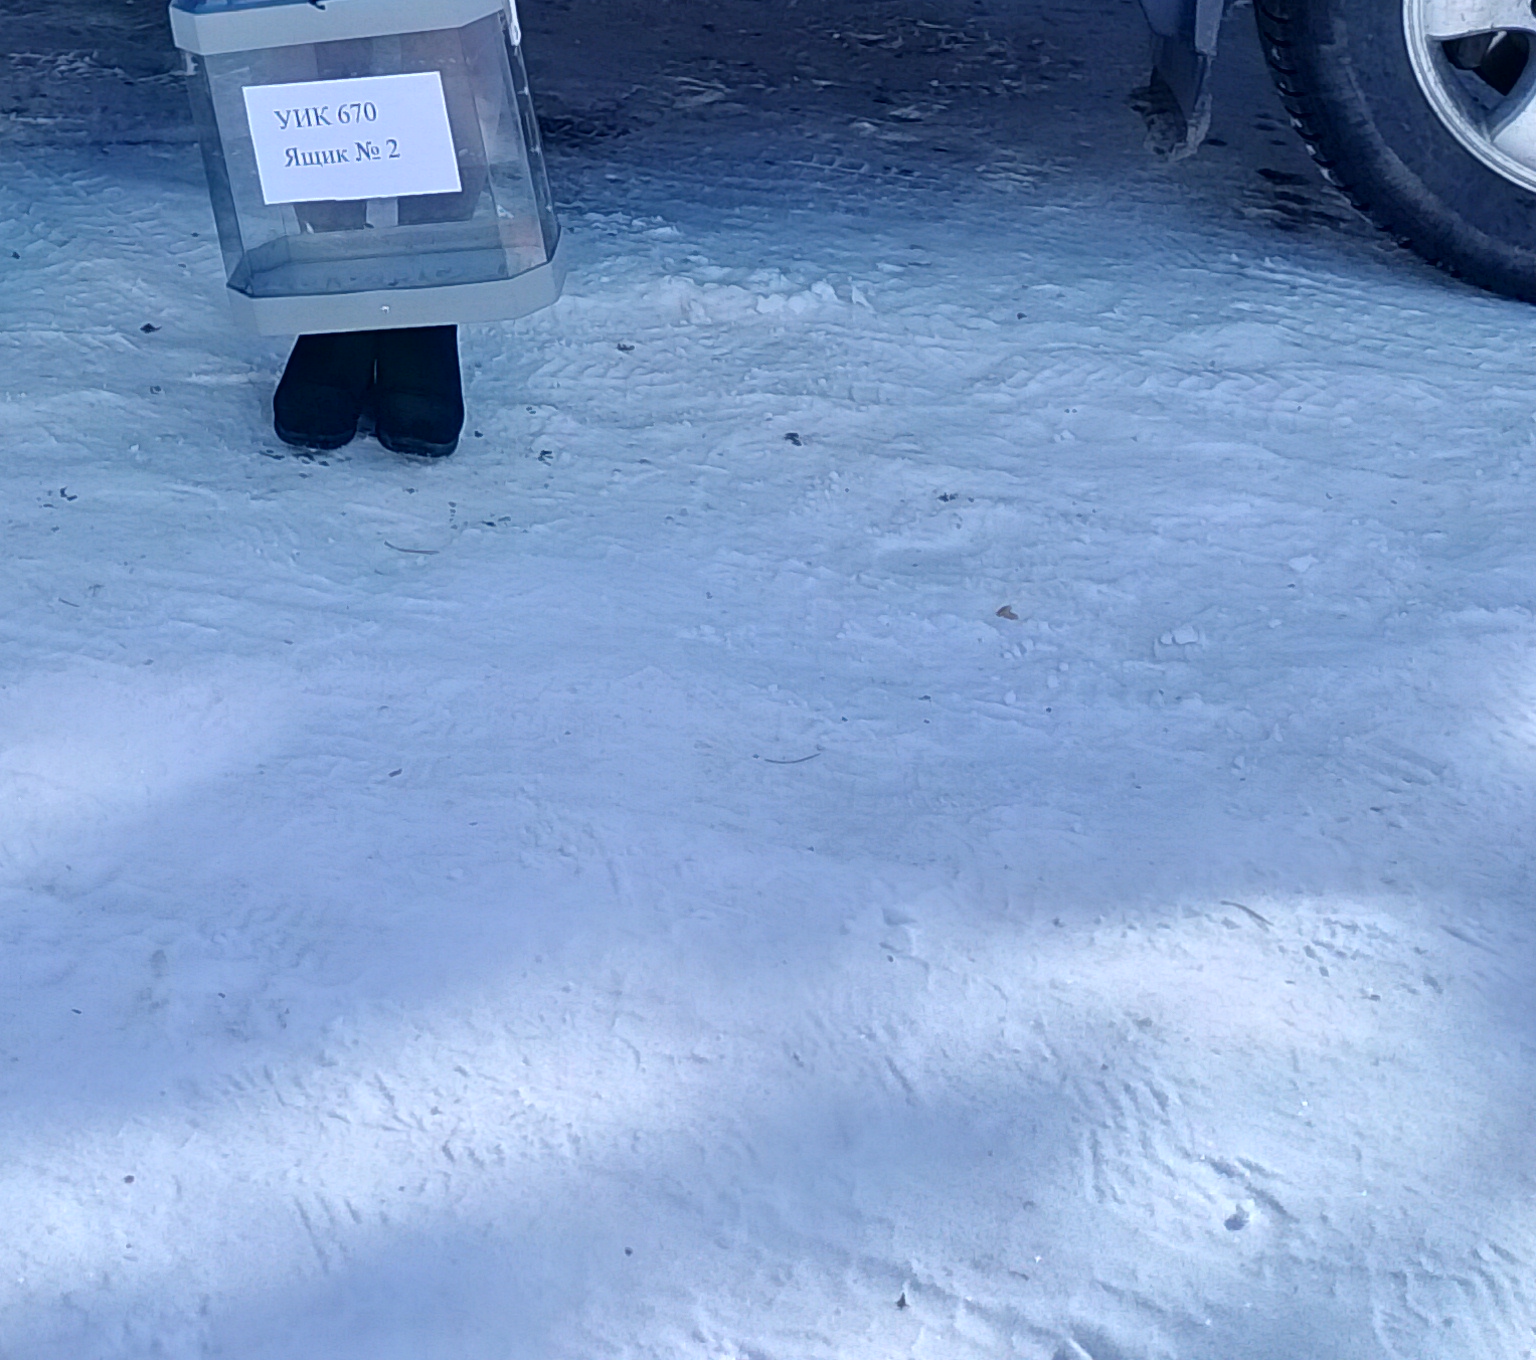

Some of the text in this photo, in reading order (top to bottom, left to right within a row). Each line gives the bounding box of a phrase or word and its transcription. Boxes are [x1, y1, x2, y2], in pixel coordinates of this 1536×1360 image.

[273, 101, 377, 130] УИК 670
[284, 138, 401, 168] Ящик № 2
